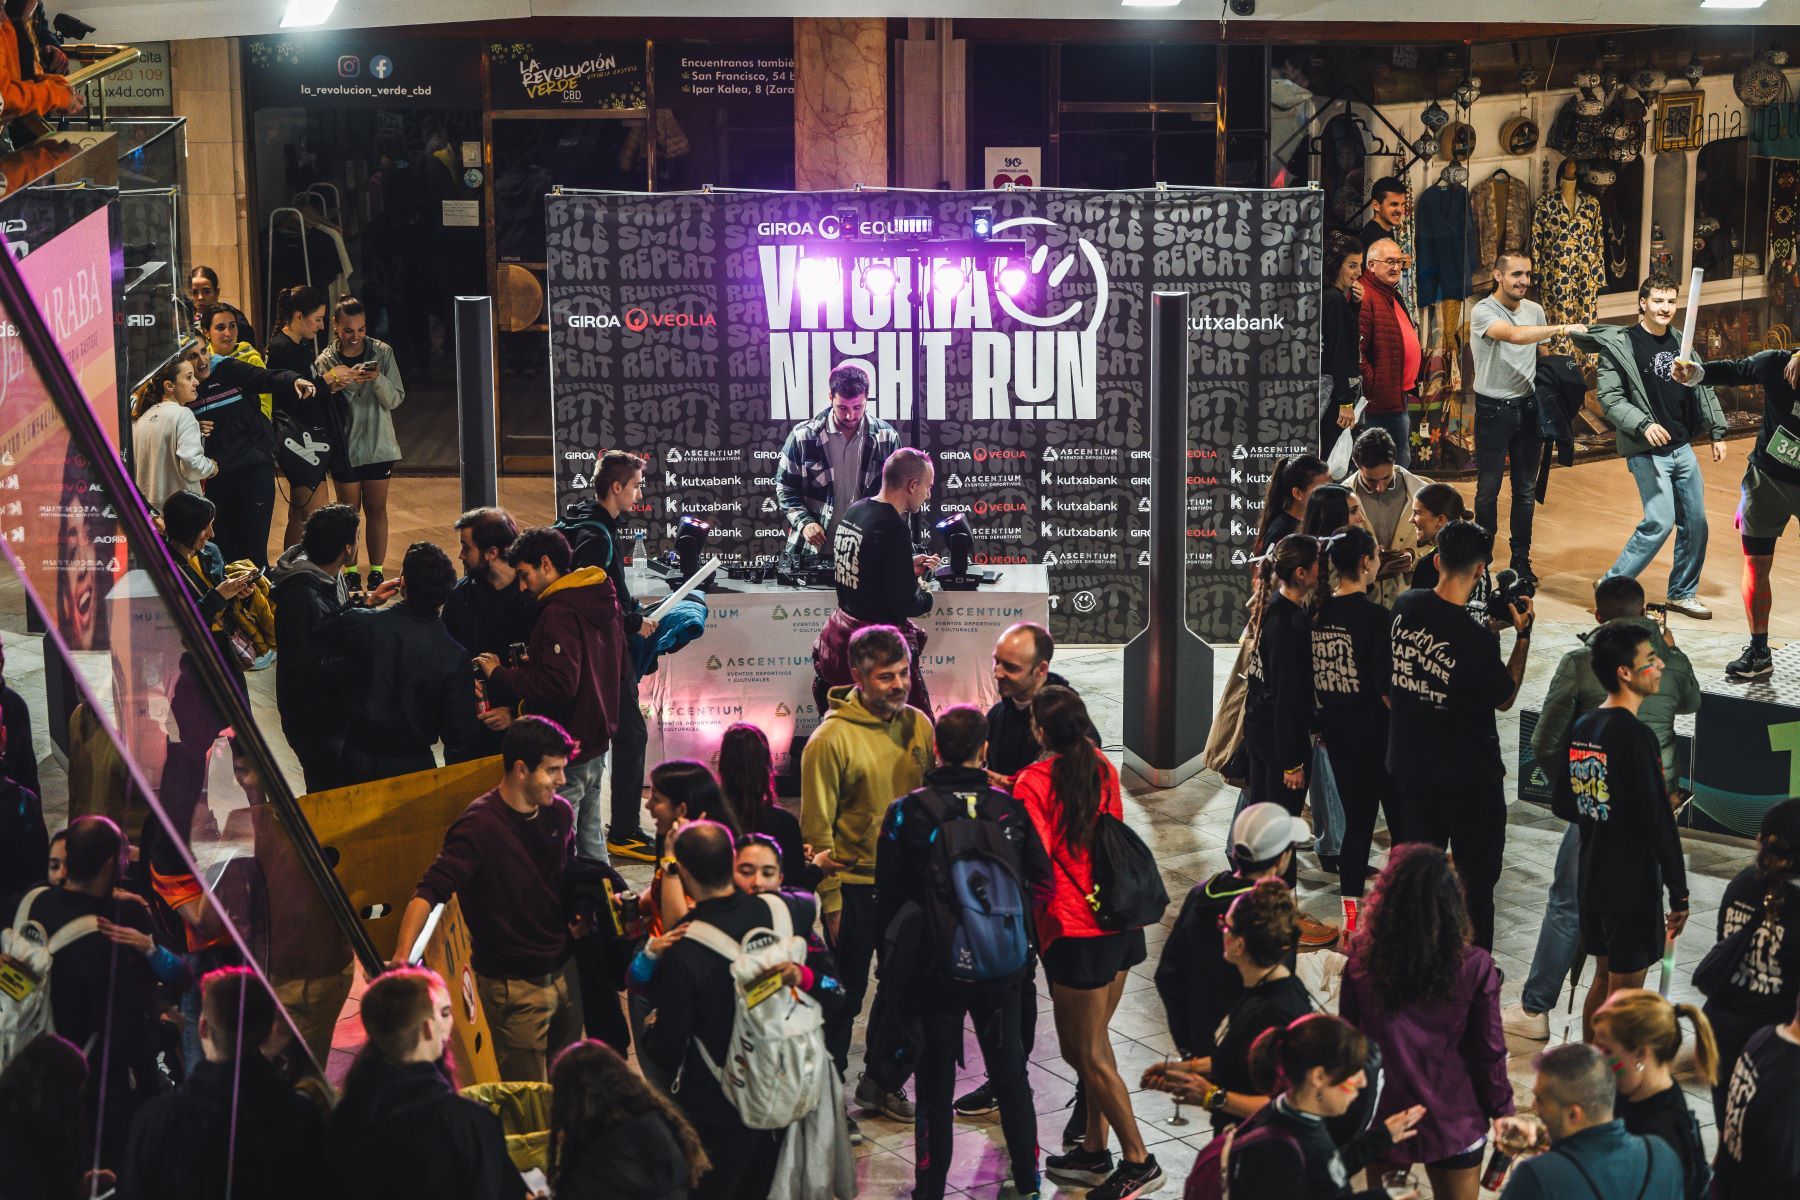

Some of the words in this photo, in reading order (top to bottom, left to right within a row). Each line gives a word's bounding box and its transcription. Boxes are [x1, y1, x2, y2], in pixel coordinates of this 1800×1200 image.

[520, 59, 540, 75] LA
[522, 53, 616, 87] REVOLUCIÓN
[681, 58, 754, 68] Encuentranos
[757, 58, 795, 68] tambié
[140, 69, 162, 80] 109
[691, 71, 712, 81] San
[716, 71, 769, 82] Francisco,
[773, 71, 786, 81] 54
[301, 84, 432, 97] la_revolucion_verde_cbd
[527, 76, 578, 99] VERDE
[563, 90, 582, 100] CBD
[692, 84, 715, 96] Ipar
[718, 84, 752, 95] Kalea,
[755, 84, 762, 94] 8
[765, 84, 795, 96] (Zara
[548, 196, 609, 227] RTY
[1153, 193, 1252, 224] PARTY
[1261, 194, 1320, 223] PAR
[757, 221, 814, 236] GIROA
[1153, 217, 1252, 251] SMILE
[547, 247, 610, 280] PEAT
[619, 246, 717, 280] REPEAT
[1153, 243, 1252, 277] REPEAT
[1261, 243, 1322, 277] REPE
[757, 244, 994, 330] VORIA
[1260, 281, 1322, 300] RUNN
[1260, 294, 1319, 322] PAR
[568, 314, 621, 328] GIROA
[651, 313, 718, 328] VEOLIA
[553, 346, 613, 379] PEAT
[621, 344, 720, 379] REPEAT
[1259, 340, 1321, 375] REPE
[972, 331, 1098, 421] RUN
[557, 392, 616, 423] RTY
[624, 391, 721, 424] PARTY
[1189, 389, 1250, 421] RTY
[1259, 393, 1317, 421] PAR
[1257, 418, 1318, 444] SMI
[565, 451, 596, 461] GIROA
[754, 451, 784, 460] GIROA
[940, 451, 972, 460] GIROA
[989, 451, 1027, 459] VEOLIA
[1061, 448, 1118, 456] ASCENTIUM
[1187, 450, 1217, 458] EOLIA
[1776, 438, 1800, 462] 34
[681, 475, 742, 487] kutxabank
[964, 474, 1021, 482] ASCENTIUM
[1057, 474, 1118, 485] kutxabank
[1187, 476, 1217, 484] EOLIA
[681, 501, 742, 513] kutxabank
[940, 504, 971, 512] GIROA
[989, 503, 1027, 512] VEOLIA
[1057, 500, 1118, 511] kutxabank
[708, 527, 742, 537] abank
[755, 528, 786, 537] GIROA
[1057, 526, 1118, 537] kutxabank
[1187, 529, 1217, 537] EOLIA
[990, 555, 1028, 564] VEOLIA
[936, 607, 1023, 617] ASCENTIUM
[727, 656, 813, 666] ASCENTIUM
